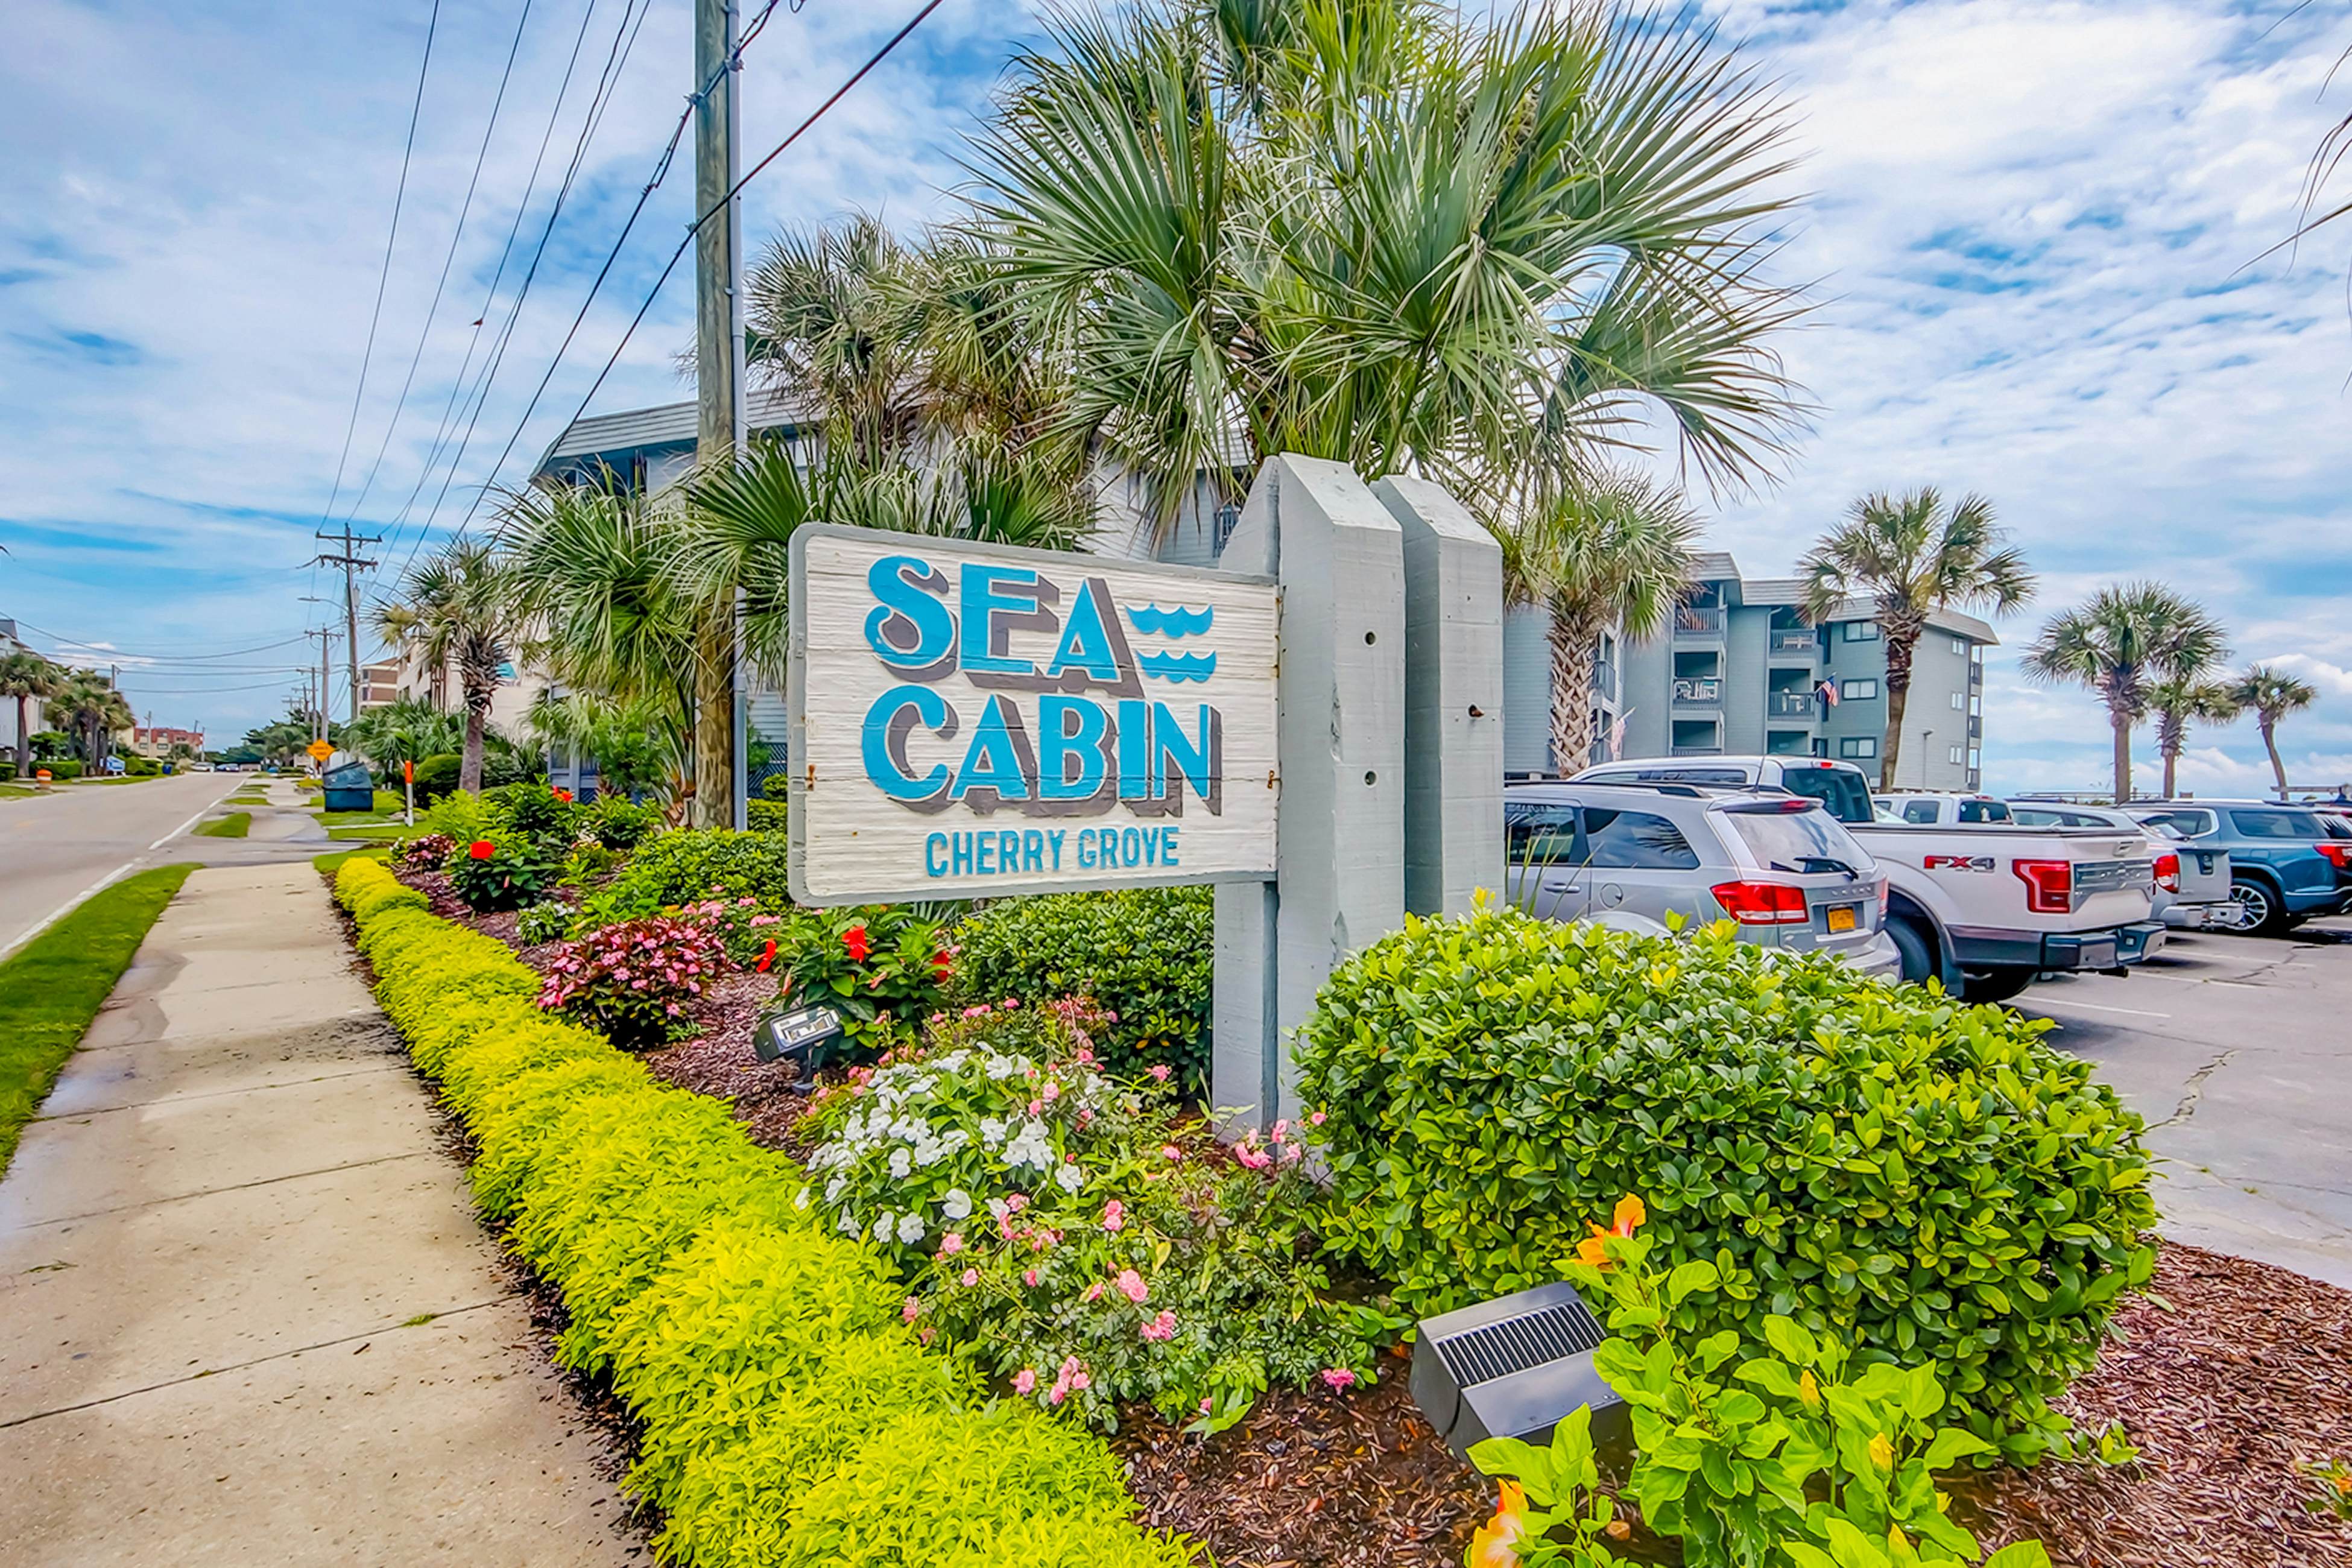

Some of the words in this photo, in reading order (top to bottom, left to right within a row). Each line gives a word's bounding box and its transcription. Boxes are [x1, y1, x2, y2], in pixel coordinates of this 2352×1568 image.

[864, 554, 1125, 683] SEA
[861, 684, 1215, 803] CABIN
[925, 829, 1067, 877] CHERRY
[1078, 826, 1180, 869] GROVE
[1924, 855, 1996, 870] FX4
